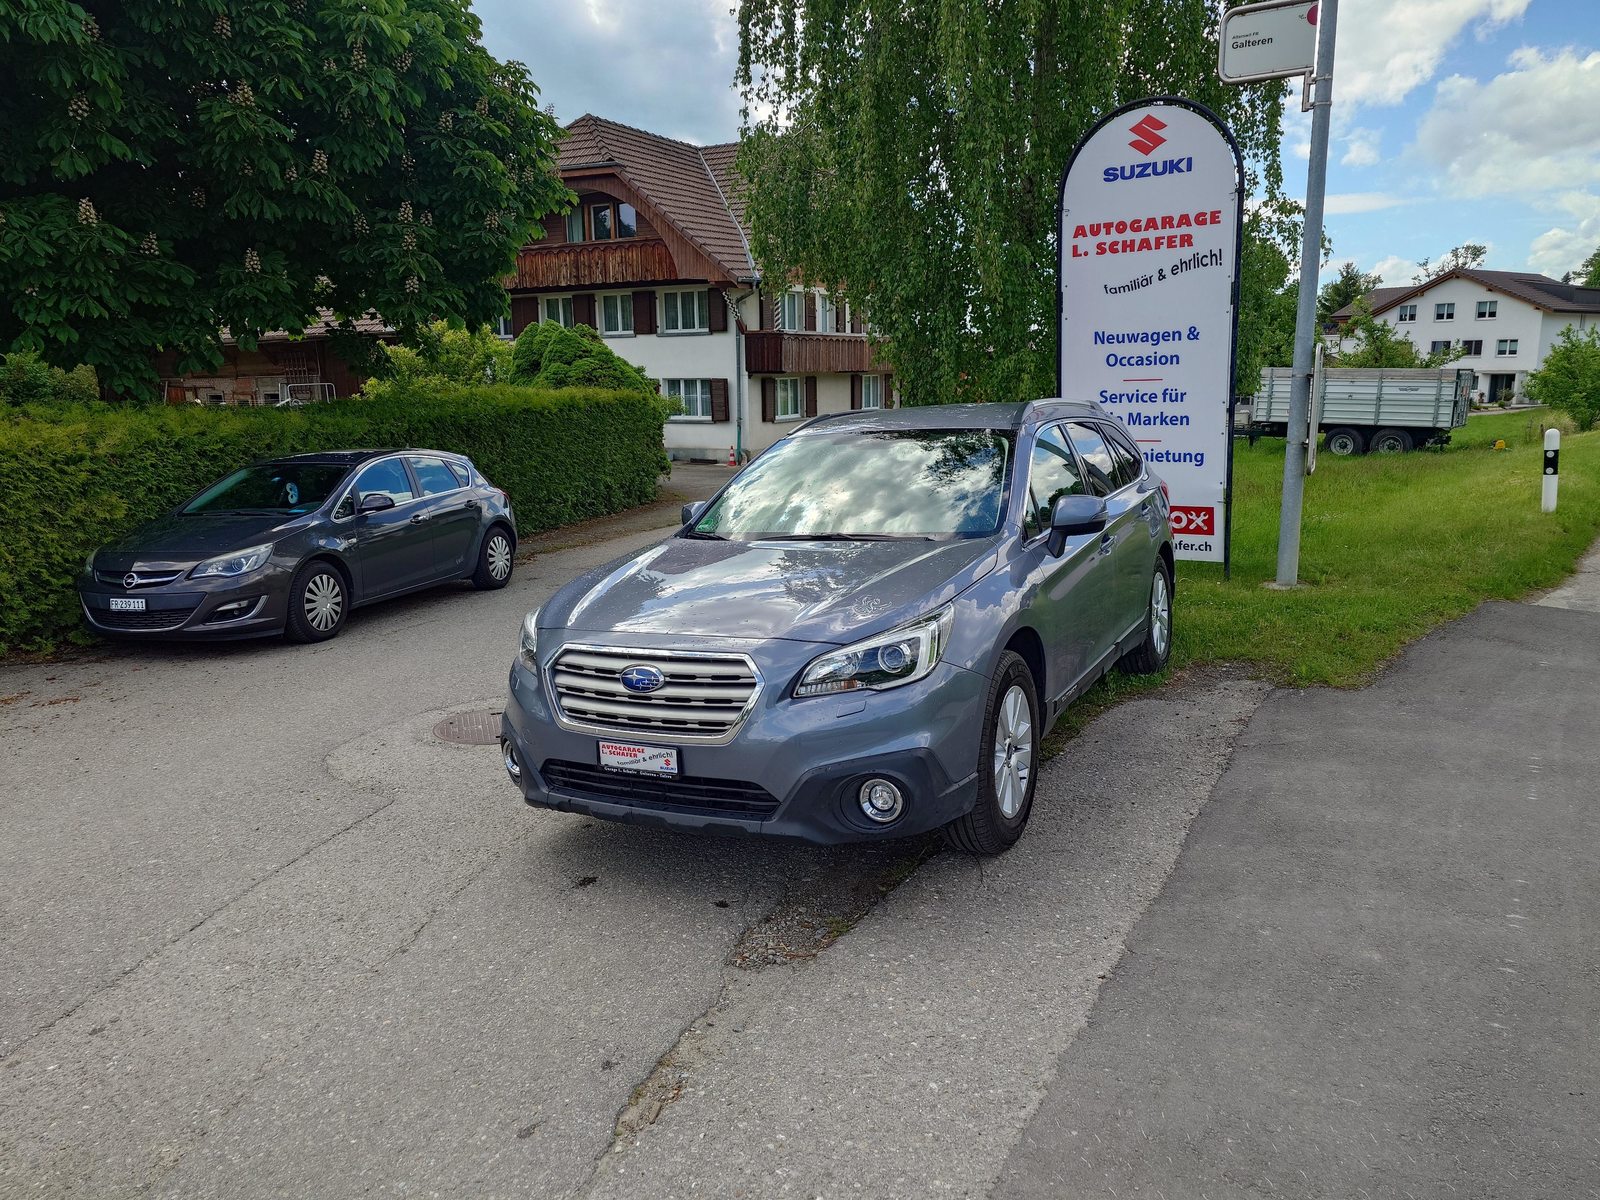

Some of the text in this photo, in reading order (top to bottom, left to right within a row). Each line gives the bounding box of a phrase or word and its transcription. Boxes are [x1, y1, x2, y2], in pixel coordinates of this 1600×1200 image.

[1231, 37, 1273, 49] Galteren
[1103, 156, 1192, 182] SUZUKI
[1072, 210, 1222, 239] AUTOGARAGE
[1072, 233, 1194, 258] L. SCHAFER
[1104, 248, 1223, 295] familiär & ehrlich!
[1094, 326, 1200, 346] Neuwagen &
[1105, 351, 1180, 367] Occasion
[1099, 388, 1187, 404] Service für
[1127, 411, 1190, 426] Marken
[601, 744, 645, 754] AUTOGARAGE
[608, 750, 638, 758] SCHAFER
